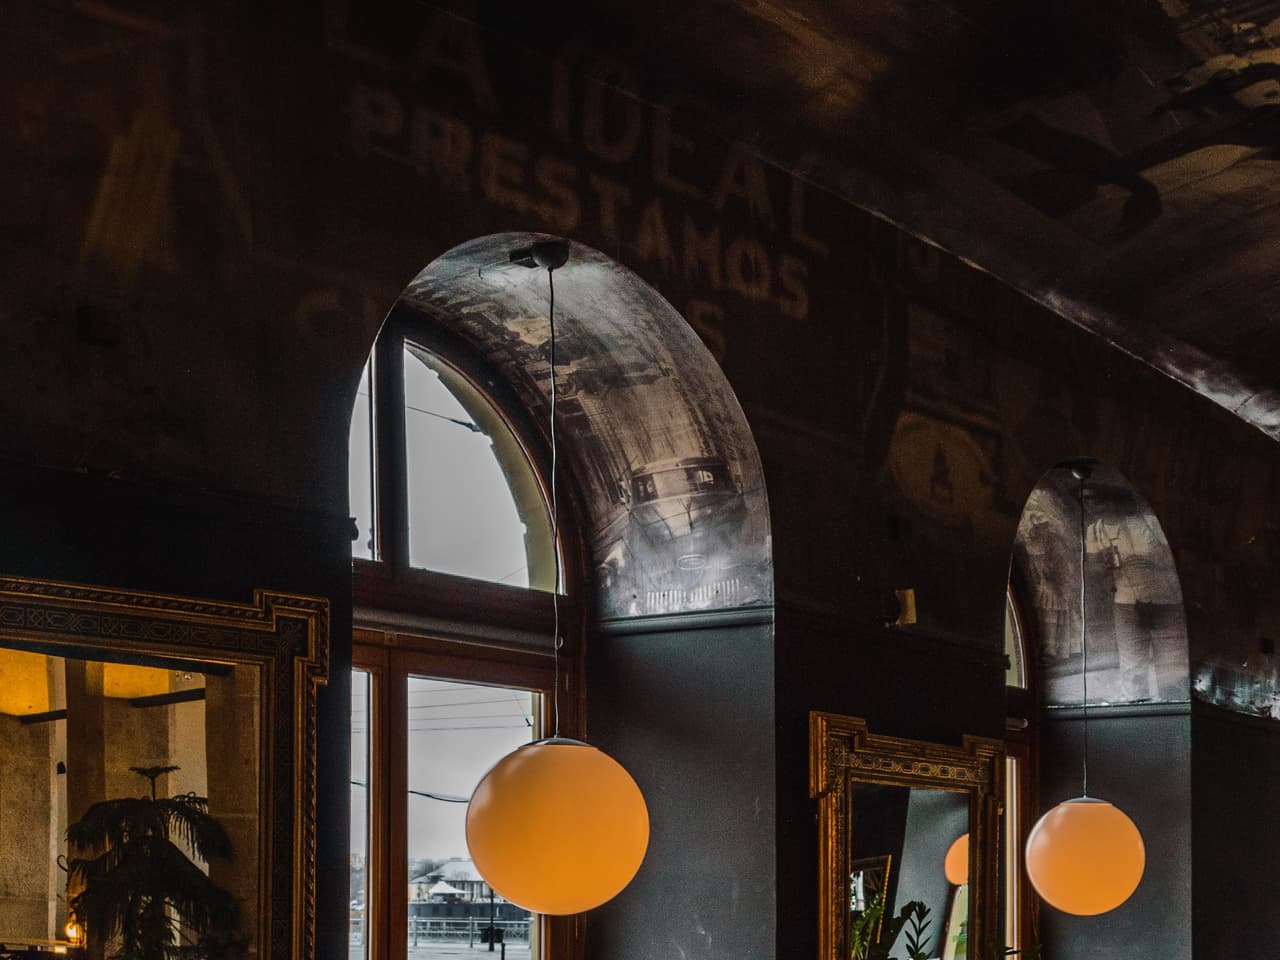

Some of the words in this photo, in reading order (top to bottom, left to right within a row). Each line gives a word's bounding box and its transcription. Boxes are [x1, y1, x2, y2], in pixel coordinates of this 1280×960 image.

[322, 0, 499, 114] LA
[548, 38, 831, 258] IDEAL
[345, 82, 811, 322] PRESTAMOS
